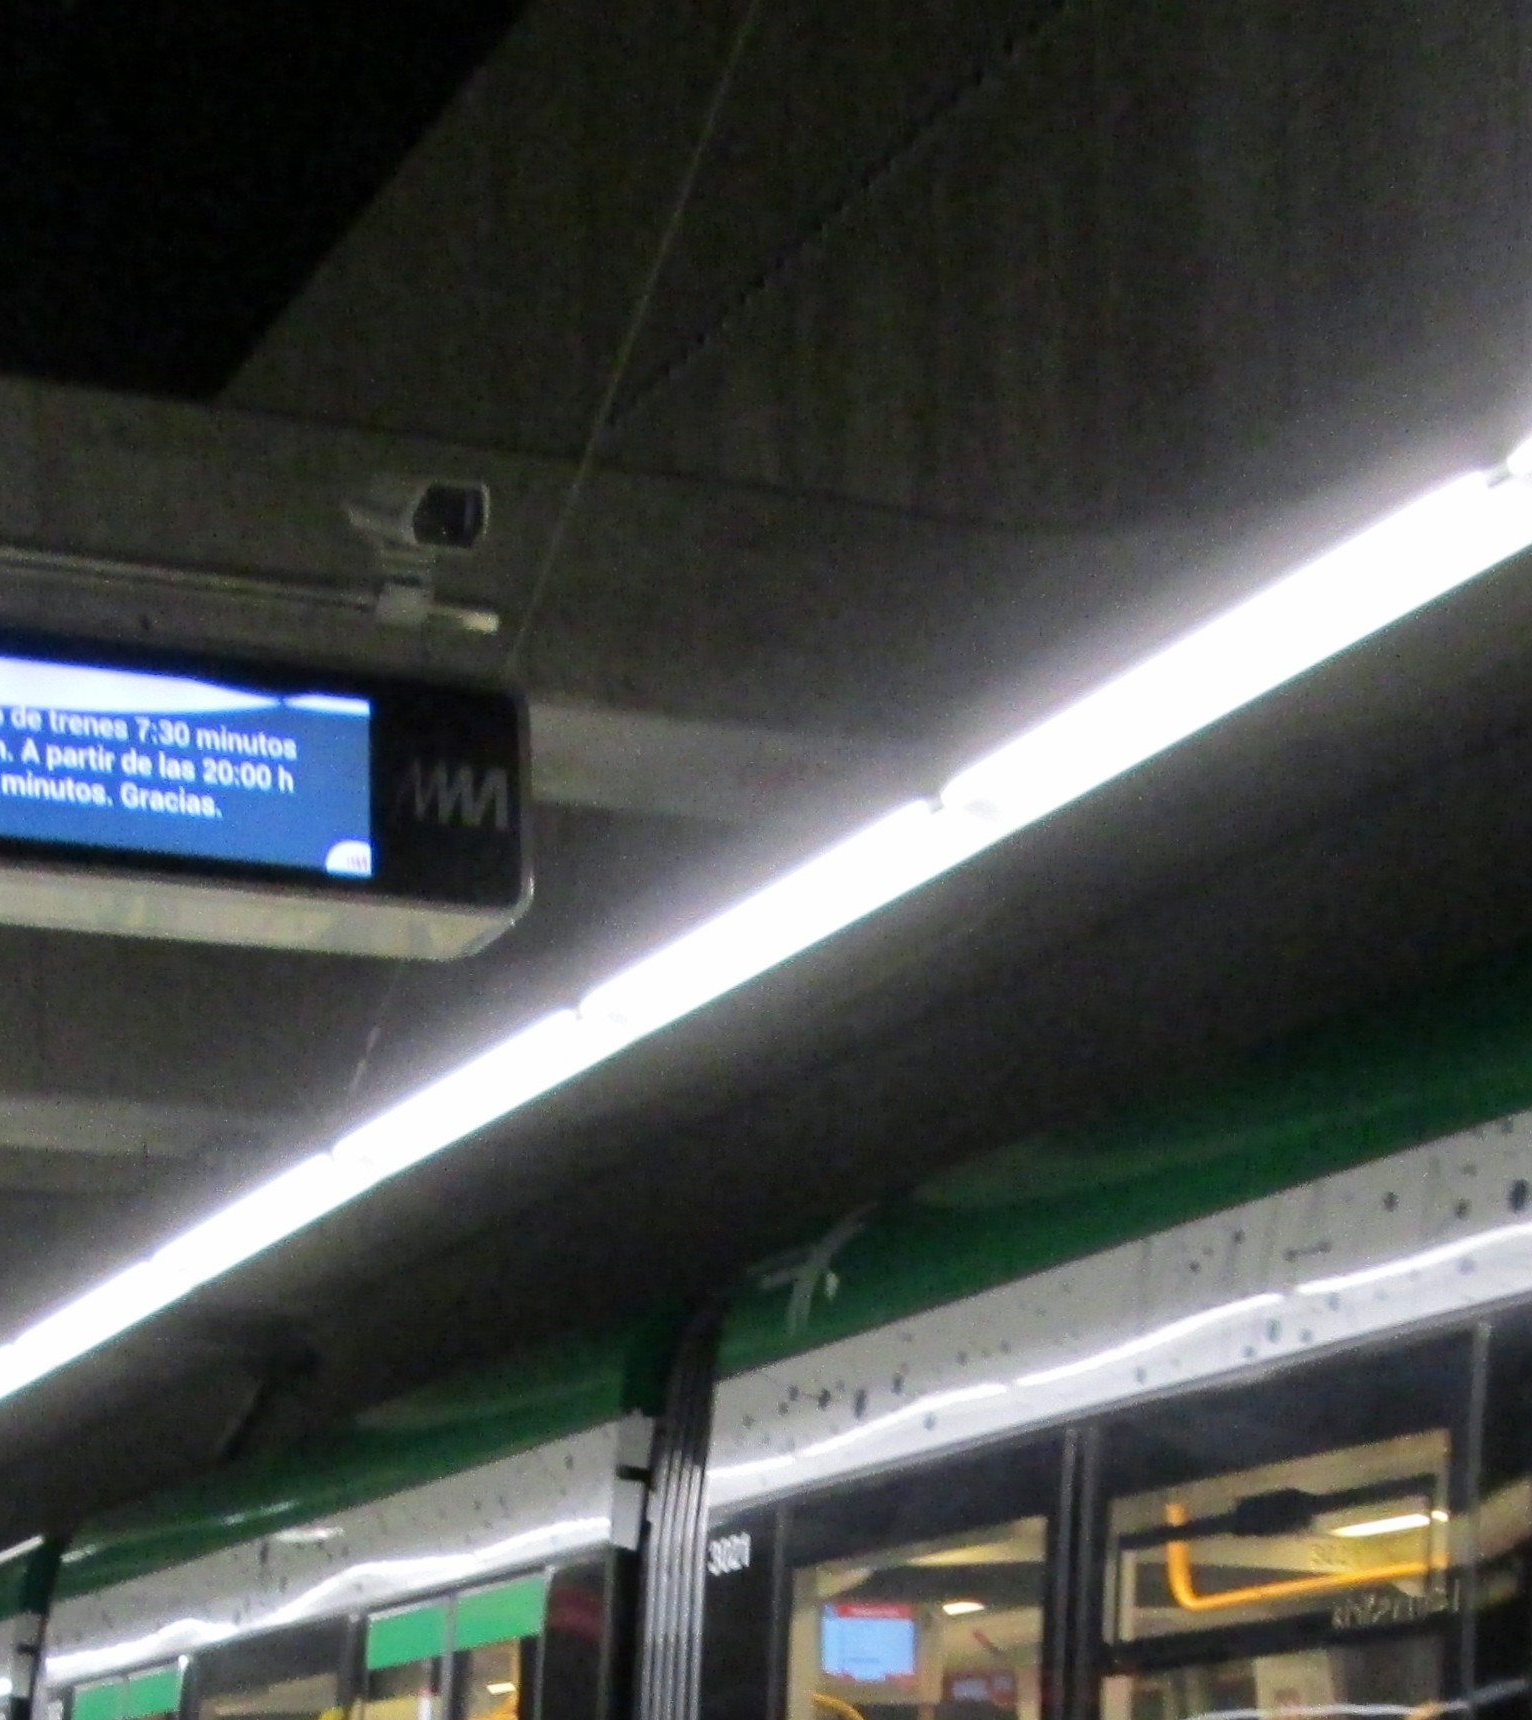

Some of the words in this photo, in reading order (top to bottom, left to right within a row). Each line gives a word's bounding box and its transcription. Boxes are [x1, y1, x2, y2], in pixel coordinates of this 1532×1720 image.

[10, 705, 41, 732] de
[49, 709, 128, 741] trenes
[135, 715, 189, 746] 7:30
[197, 725, 297, 760] minutos
[21, 738, 40, 764] A
[47, 744, 115, 773] partir
[121, 748, 152, 778] de
[159, 751, 195, 782] las
[202, 757, 272, 791] 20:00
[278, 765, 294, 793] h
[1, 768, 113, 807] minutos.
[121, 781, 223, 819] Gracias.
